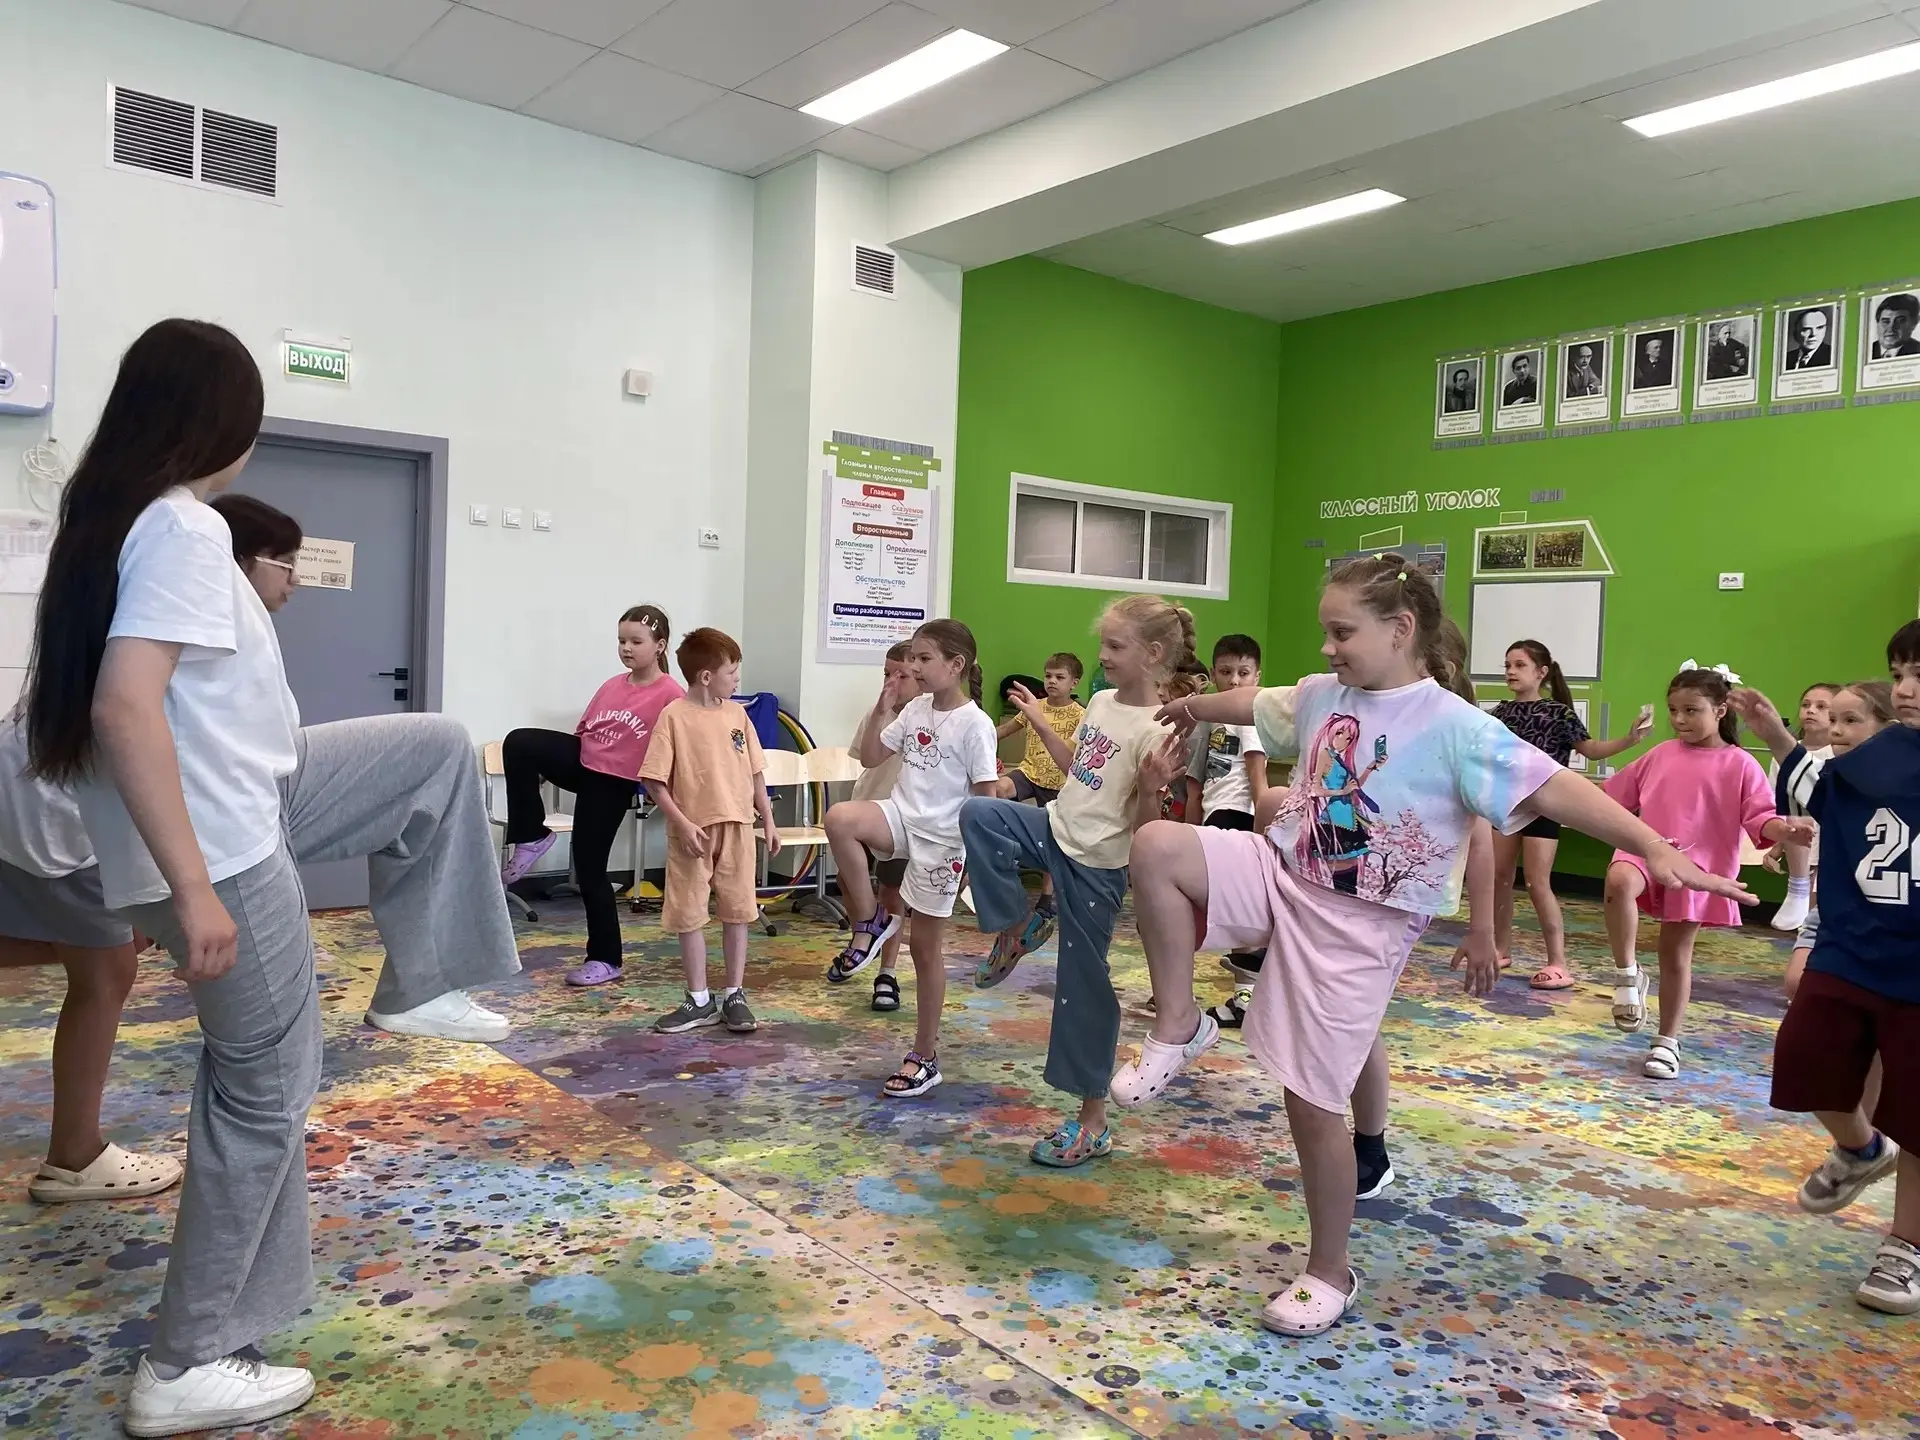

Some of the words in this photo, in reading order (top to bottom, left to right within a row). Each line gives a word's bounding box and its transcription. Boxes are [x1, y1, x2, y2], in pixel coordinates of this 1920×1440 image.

[290, 350, 345, 376] ВЫХОД
[841, 458, 867, 469] Главные
[873, 466, 924, 477] второстепенные
[852, 470, 872, 478] члены
[872, 473, 913, 484] предложения
[869, 487, 897, 498] Главные
[841, 498, 882, 510] Подлежащее
[1320, 490, 1418, 519] КЛАССНЫЙ
[1425, 487, 1501, 512] УГОЛОК
[891, 504, 924, 515] Сказуемое
[856, 525, 909, 537] Второстепенные
[835, 539, 874, 549] Дополнение
[886, 544, 928, 555] Определение
[855, 575, 906, 586] Обстоятельство
[835, 605, 859, 615] Пример
[859, 606, 884, 616] разбора
[884, 609, 922, 618] предложения
[830, 620, 849, 628] Завтра
[854, 622, 888, 630] родителями
[829, 635, 871, 643] замечательное
[586, 709, 649, 740] CALIFORNIA
